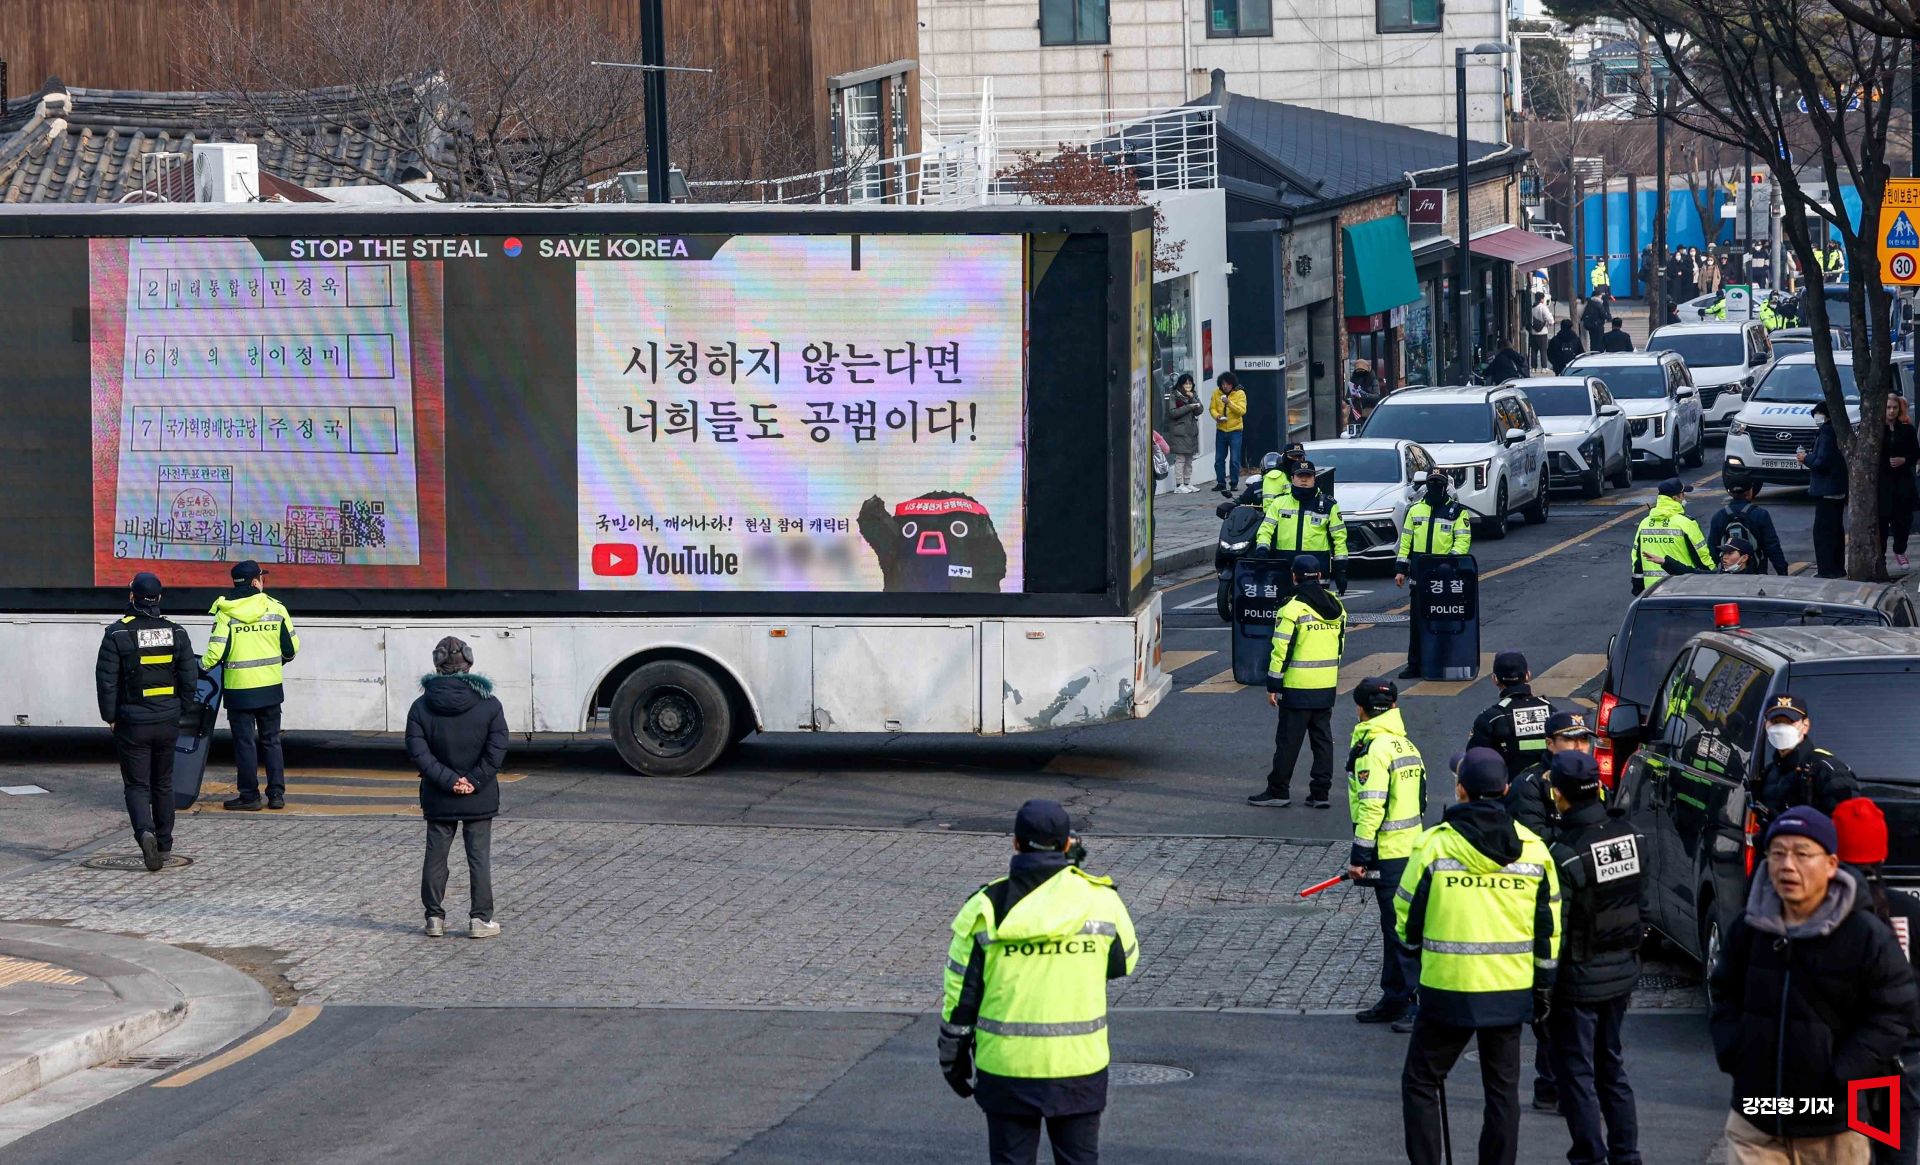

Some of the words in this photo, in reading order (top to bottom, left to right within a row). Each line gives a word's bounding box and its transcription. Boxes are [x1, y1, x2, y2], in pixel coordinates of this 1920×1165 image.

[1883, 187, 1920, 205] 린이보호구
[1416, 199, 1435, 211] fru
[290, 239, 353, 258] STOP
[359, 239, 406, 258] THE
[412, 239, 488, 258] STEAL
[539, 239, 600, 258] SAVE
[607, 239, 689, 258] KOREA
[1896, 259, 1911, 275] 30
[147, 281, 159, 297] 2
[145, 348, 155, 365] 6
[268, 345, 339, 366] 이정미
[623, 341, 780, 385] 시청하지
[801, 341, 963, 385] 않는다면
[1244, 359, 1271, 368] tanello
[141, 419, 152, 437] 7
[165, 417, 258, 439] 국가혁명배당금당
[623, 399, 784, 443] 너희들도
[800, 399, 977, 443] 공범이다!
[160, 467, 231, 481] 사전투표관리관
[596, 514, 659, 532] 국민이여,
[664, 514, 733, 532] 깨어나라!
[745, 517, 772, 533] 현실
[777, 517, 804, 533] 참여
[809, 517, 850, 533] 캐릭터
[115, 540, 129, 559] 3
[643, 544, 738, 576] YouTube
[1244, 583, 1279, 598] 경찰
[1430, 579, 1465, 594] 경찰
[1244, 609, 1278, 619] POLICE
[1430, 605, 1465, 614] POLICE
[235, 623, 278, 634] POLICE
[1306, 623, 1340, 632] POLICE
[1519, 724, 1544, 733] POLIC
[1594, 839, 1633, 865] 경찰
[1601, 861, 1635, 877] POLICE
[1446, 876, 1525, 890] POLICE
[1003, 940, 1097, 956] POLICE
